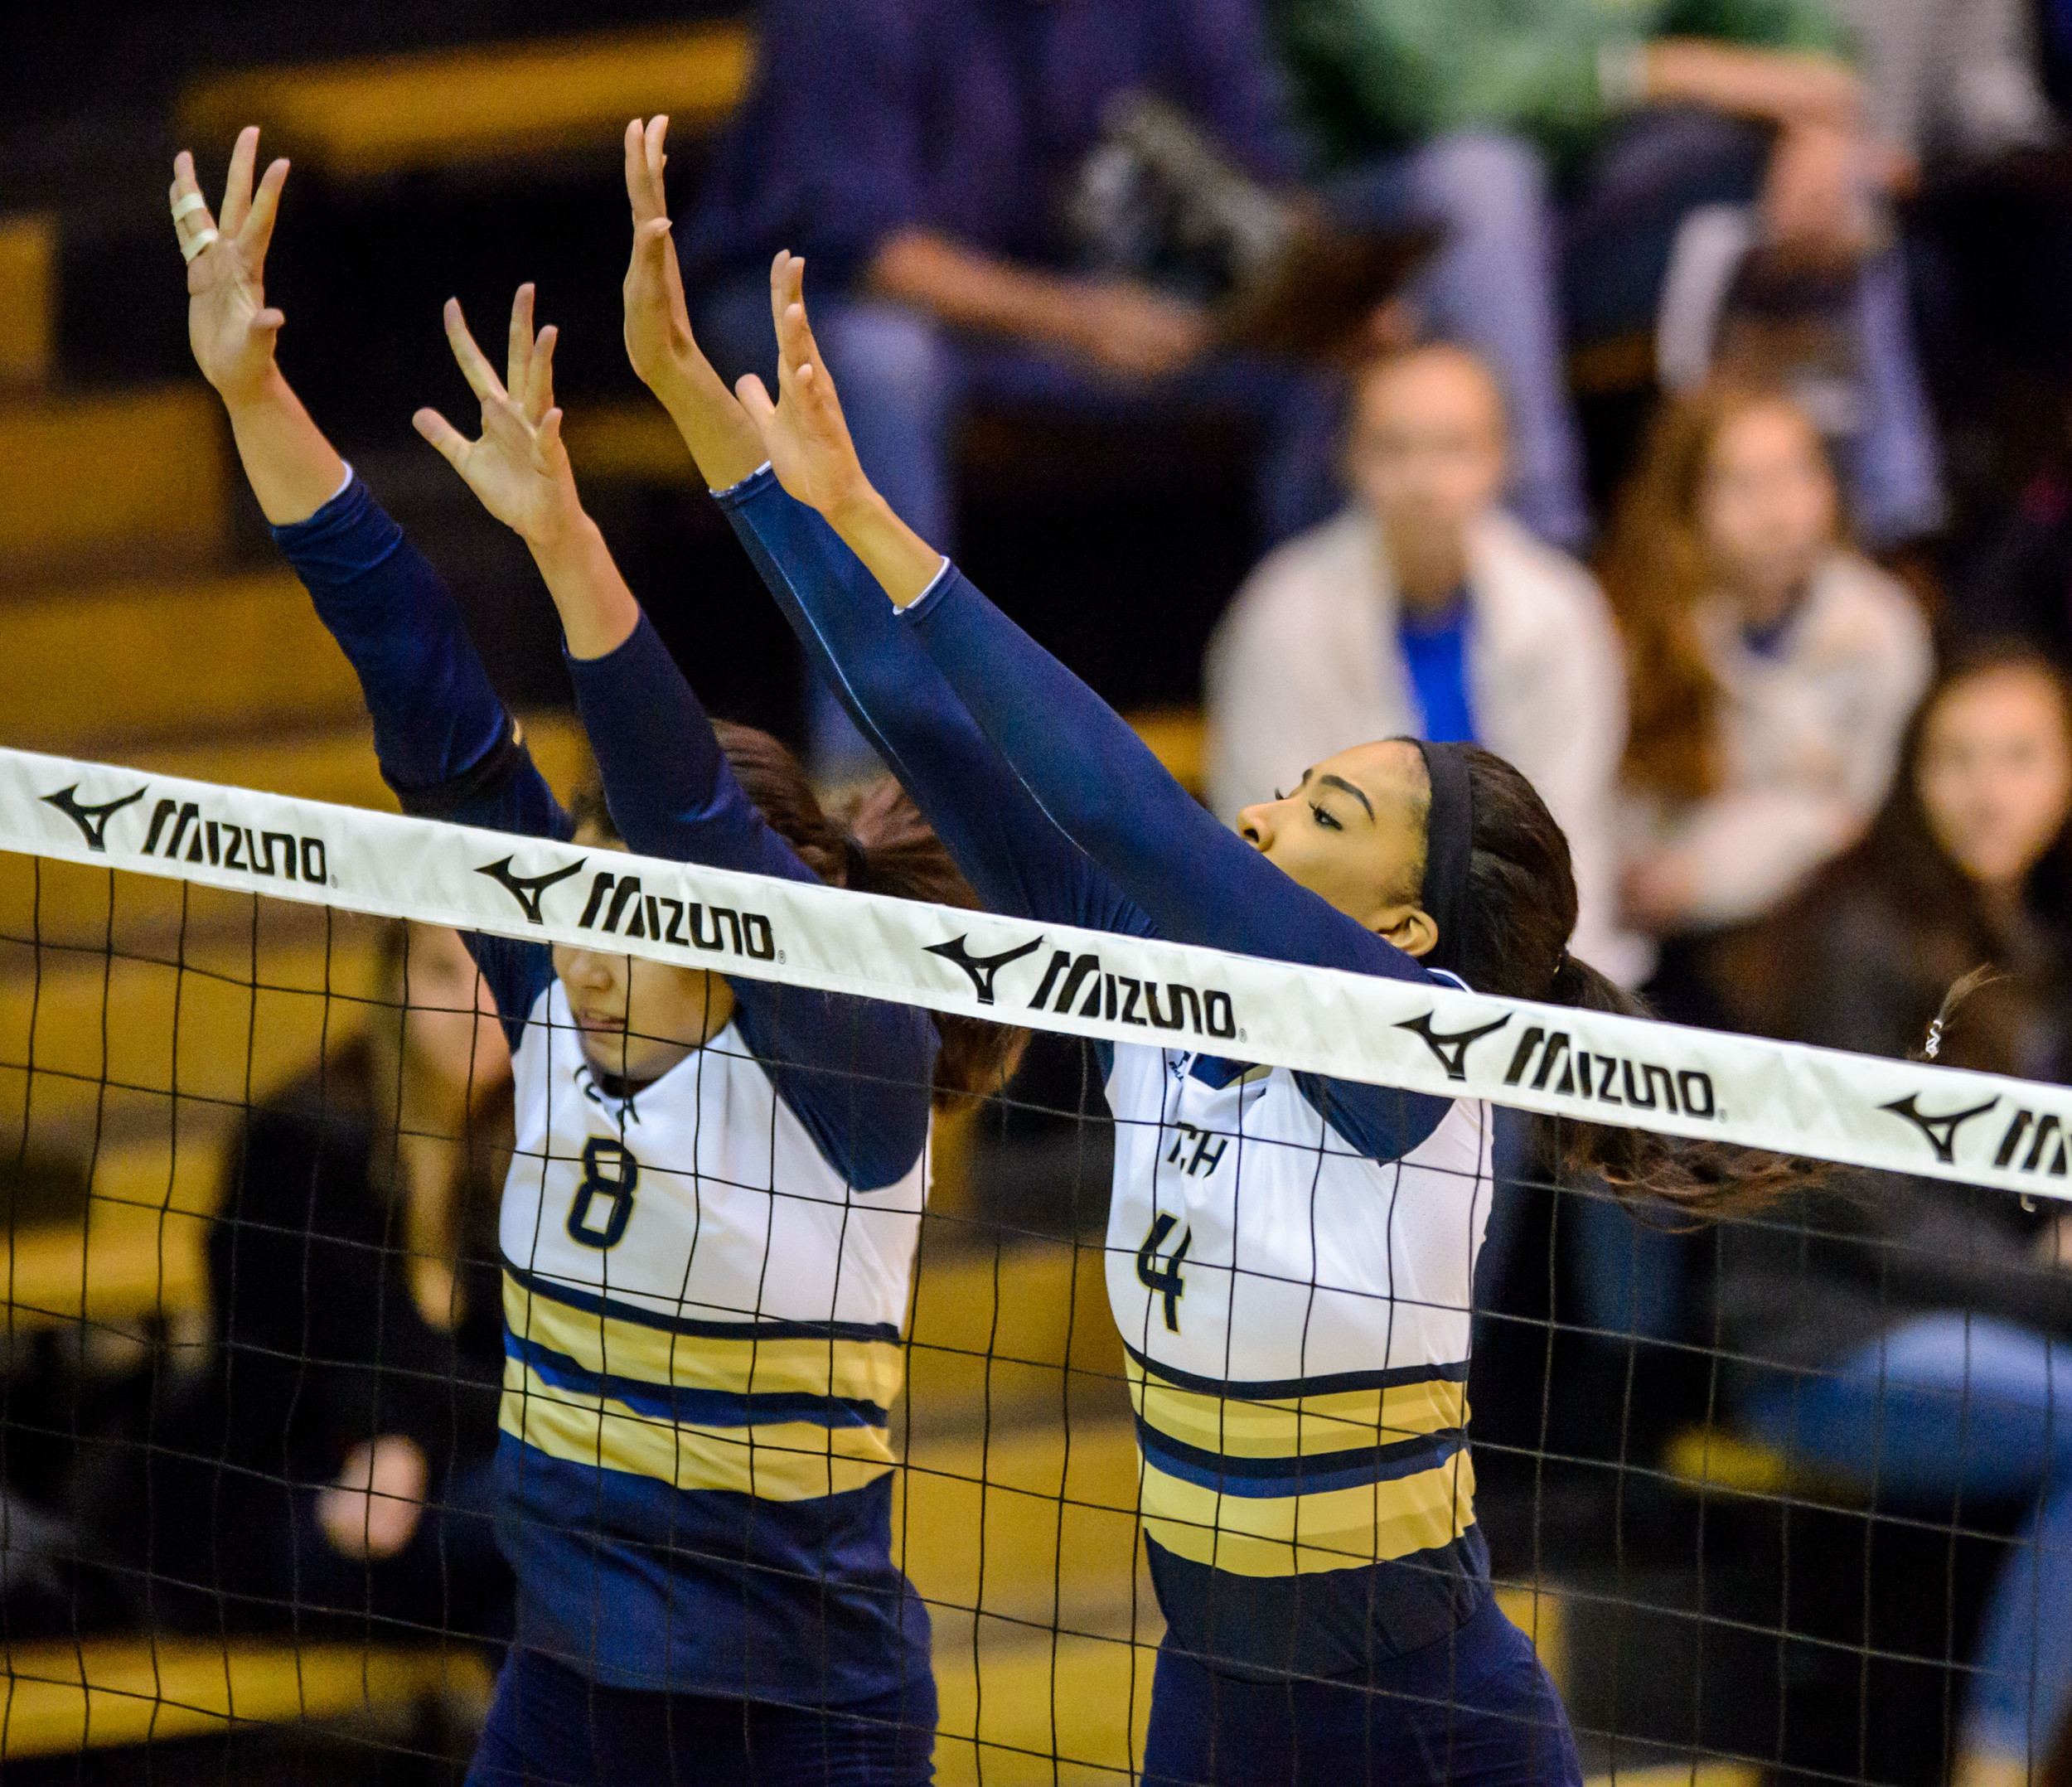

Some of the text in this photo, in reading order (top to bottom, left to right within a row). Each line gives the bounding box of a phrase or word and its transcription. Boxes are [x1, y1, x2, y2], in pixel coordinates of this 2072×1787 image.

[566, 1135, 639, 1251] 8
[1992, 1108, 2072, 1177] M
[1137, 1210, 1192, 1334] 4
